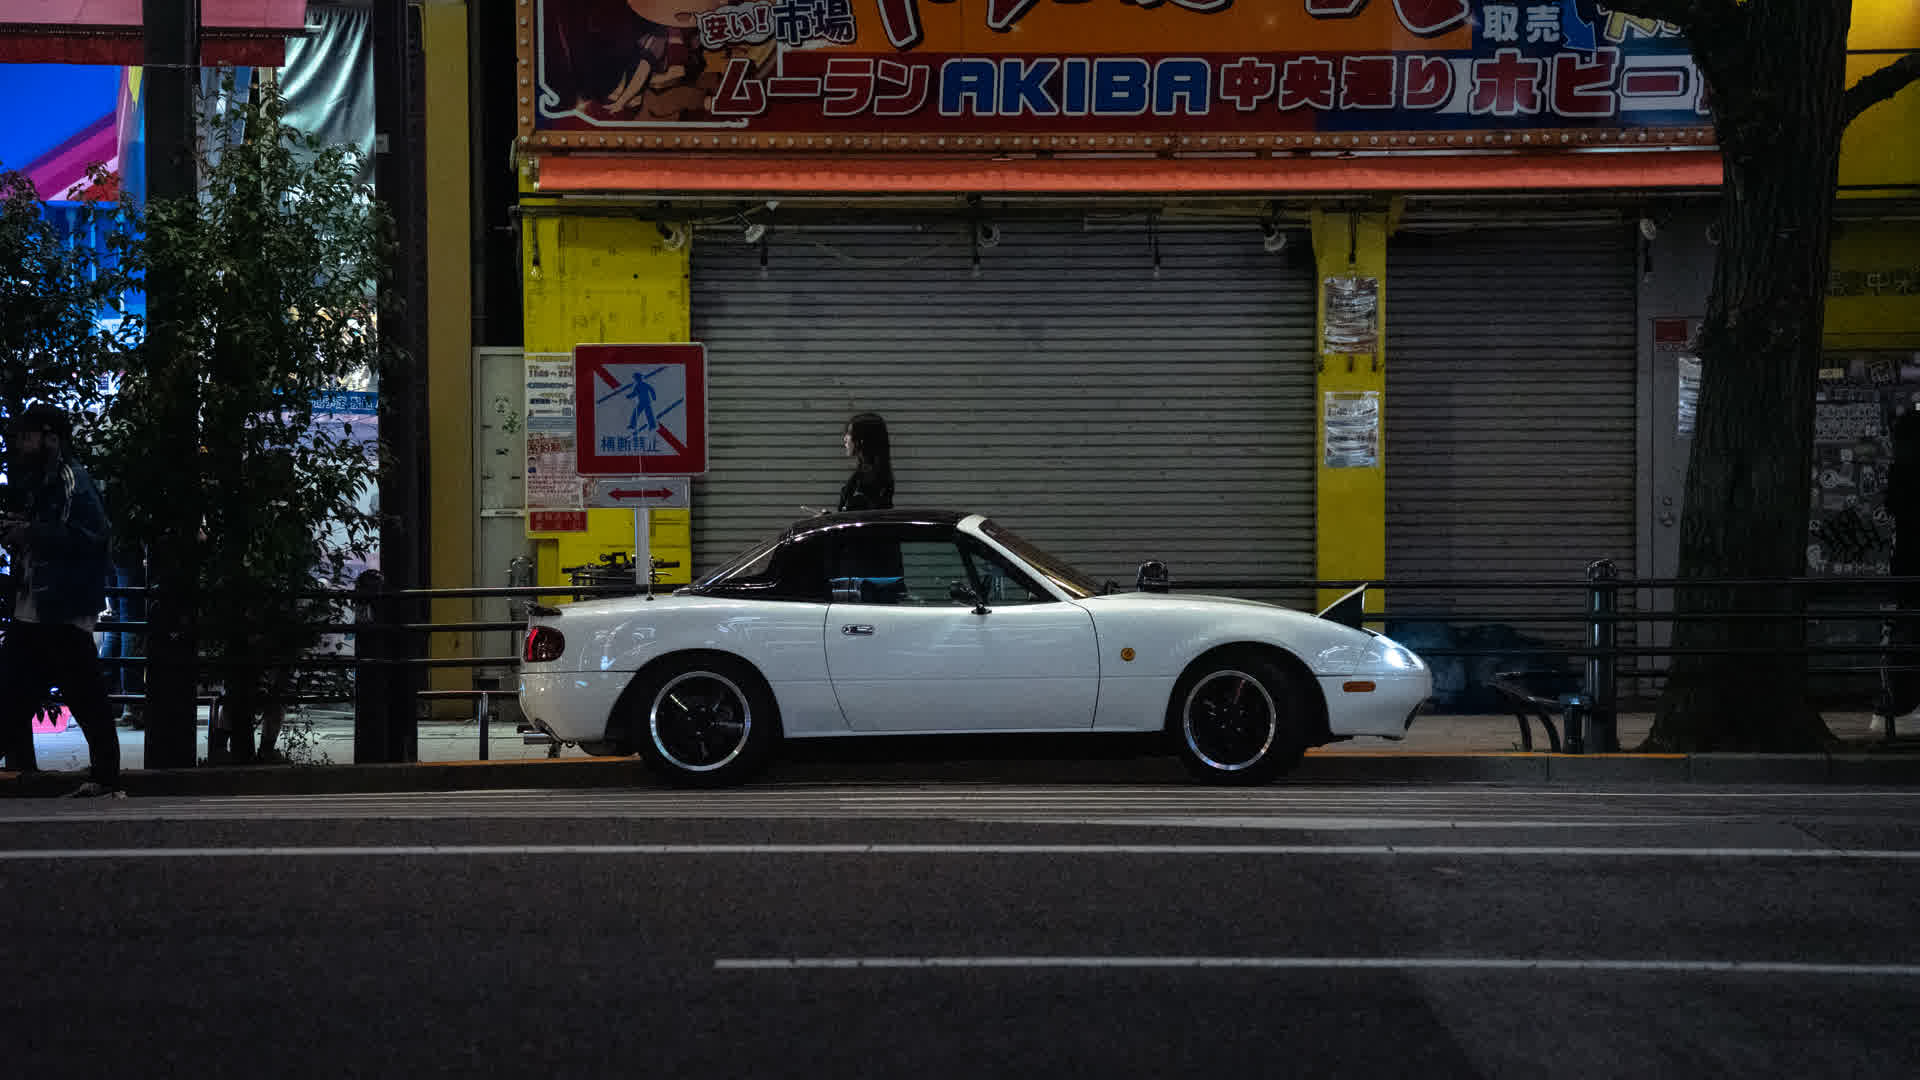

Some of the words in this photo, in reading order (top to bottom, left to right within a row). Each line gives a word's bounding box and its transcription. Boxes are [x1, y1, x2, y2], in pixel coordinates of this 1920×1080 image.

[774, 0, 855, 44] 市場
[938, 57, 1211, 117] AKIBA
[1468, 47, 1712, 117] ホビー
[600, 433, 660, 453] 横断禁止
